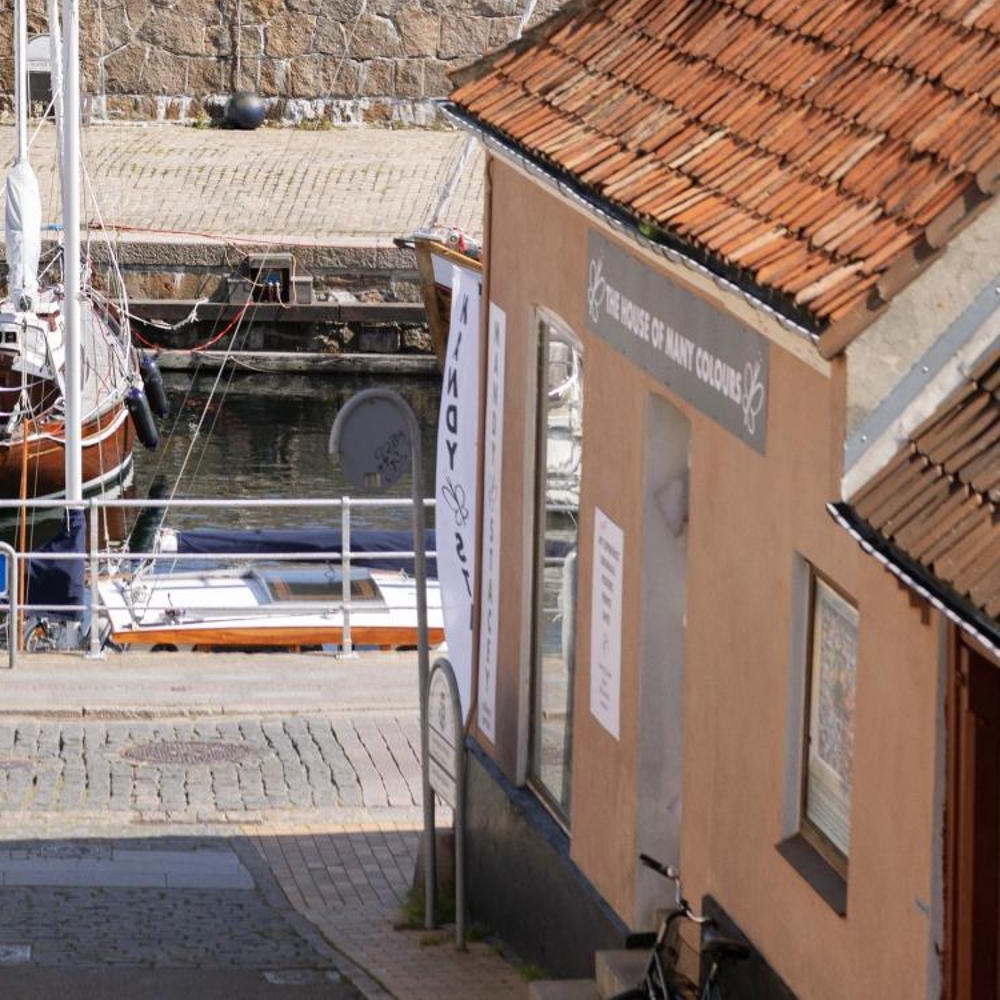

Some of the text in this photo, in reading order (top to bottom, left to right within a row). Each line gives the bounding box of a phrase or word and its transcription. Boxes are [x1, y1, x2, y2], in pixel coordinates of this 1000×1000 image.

[606, 285, 742, 405] THE HOUSE OF MANY COLOURS
